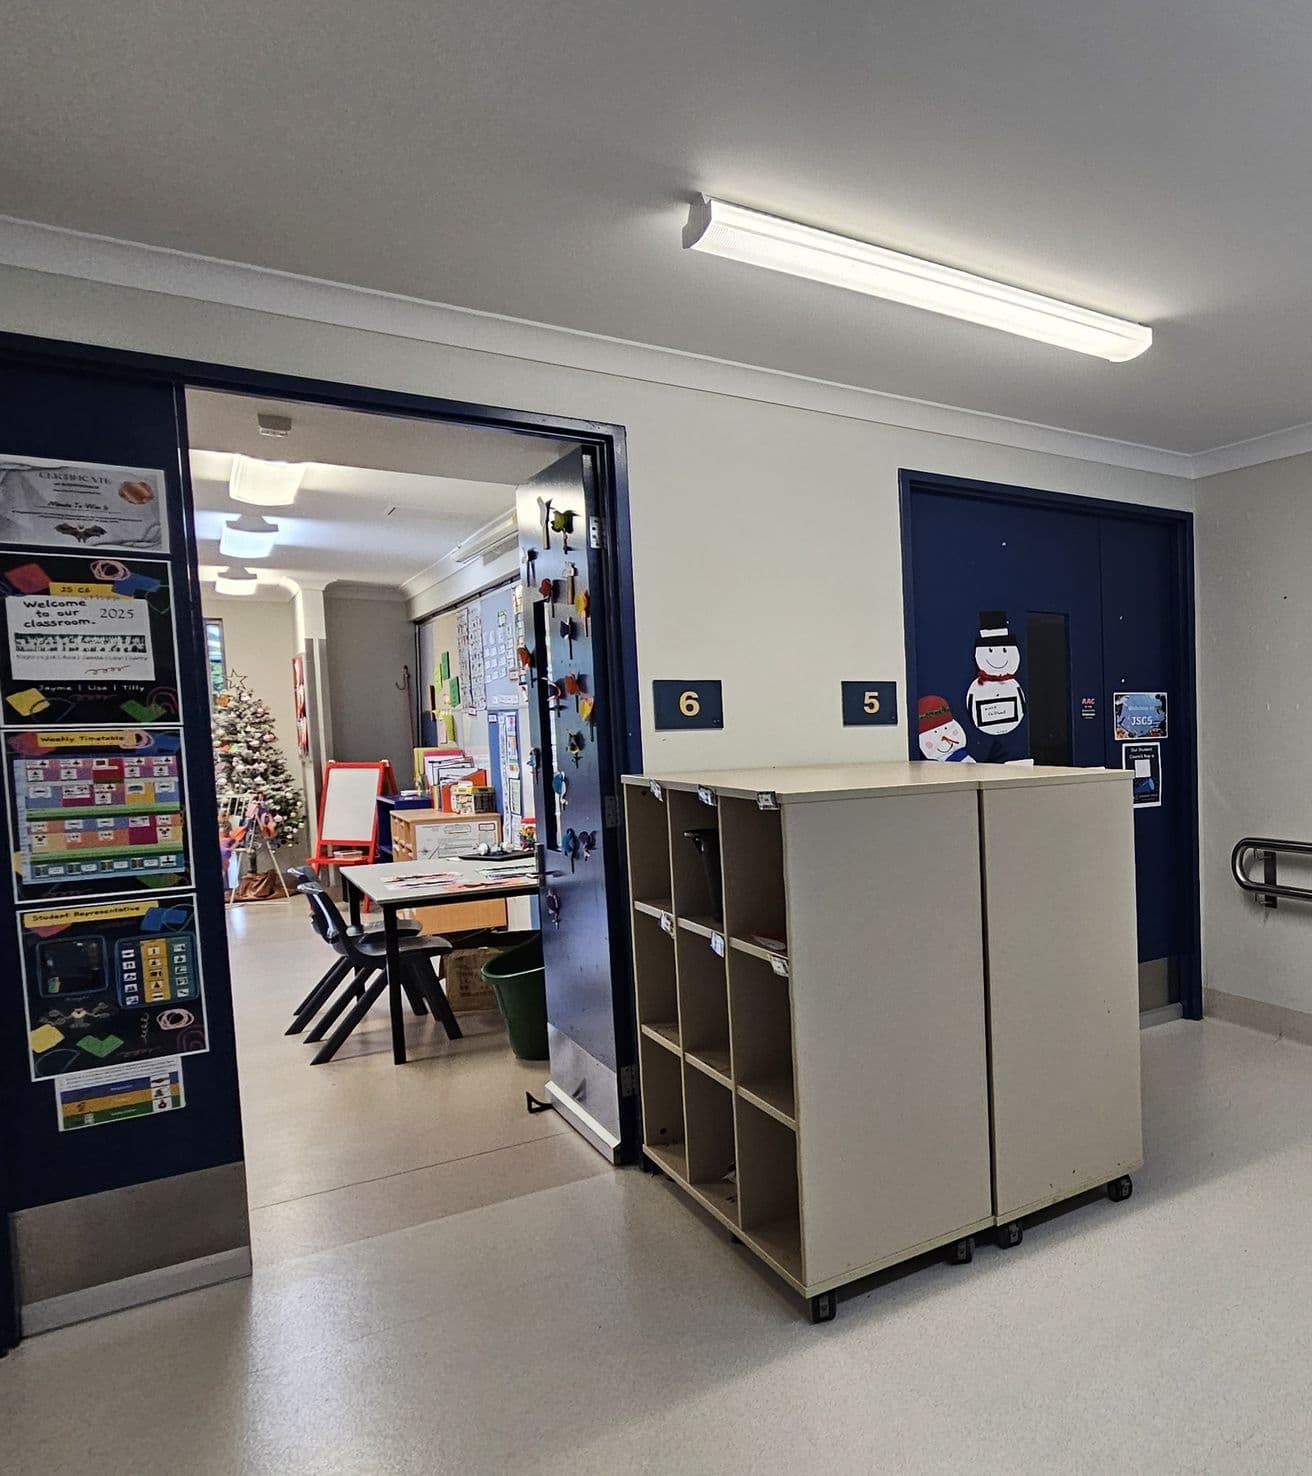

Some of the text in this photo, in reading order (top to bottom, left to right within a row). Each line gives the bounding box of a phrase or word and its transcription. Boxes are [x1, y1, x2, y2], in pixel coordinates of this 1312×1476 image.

[23, 599, 87, 609] Welcome
[35, 609, 80, 618] to our
[99, 608, 134, 619] 2025
[23, 619, 96, 628] classroom.
[122, 684, 145, 693] Tilly
[679, 690, 701, 717] 6
[863, 691, 880, 714] 5
[32, 906, 140, 921] Student Representative
